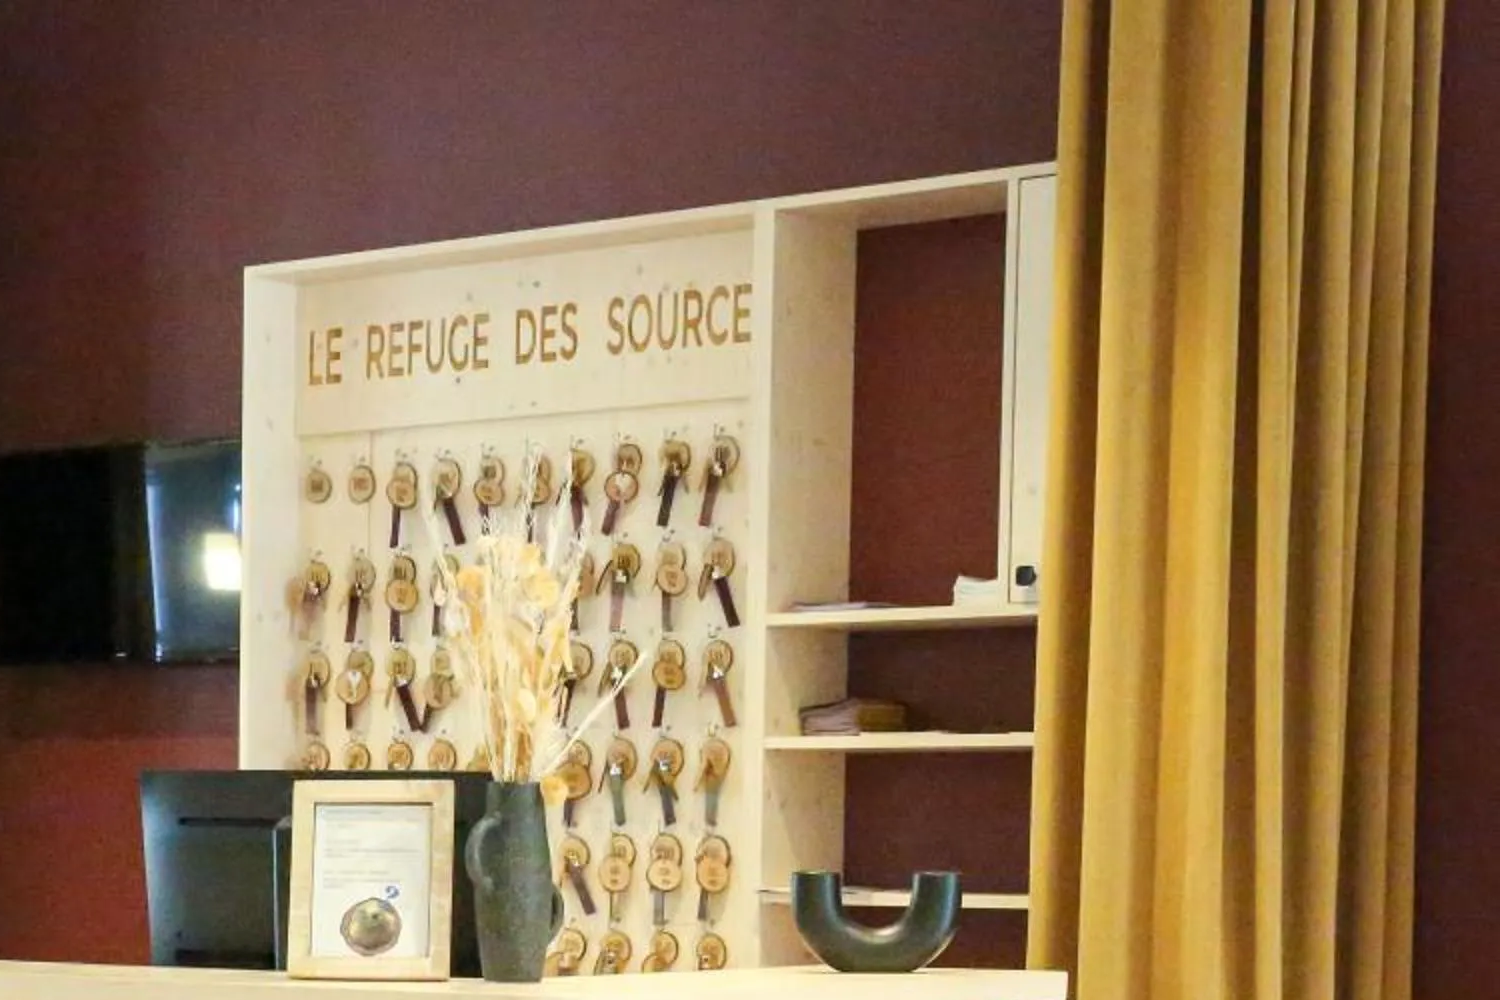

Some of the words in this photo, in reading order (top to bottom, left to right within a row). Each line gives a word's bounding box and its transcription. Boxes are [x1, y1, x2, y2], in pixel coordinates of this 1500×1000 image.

[309, 327, 343, 386] LE
[365, 313, 490, 379] REFUGE
[514, 302, 579, 365] DES
[605, 283, 753, 355] SOURCE
